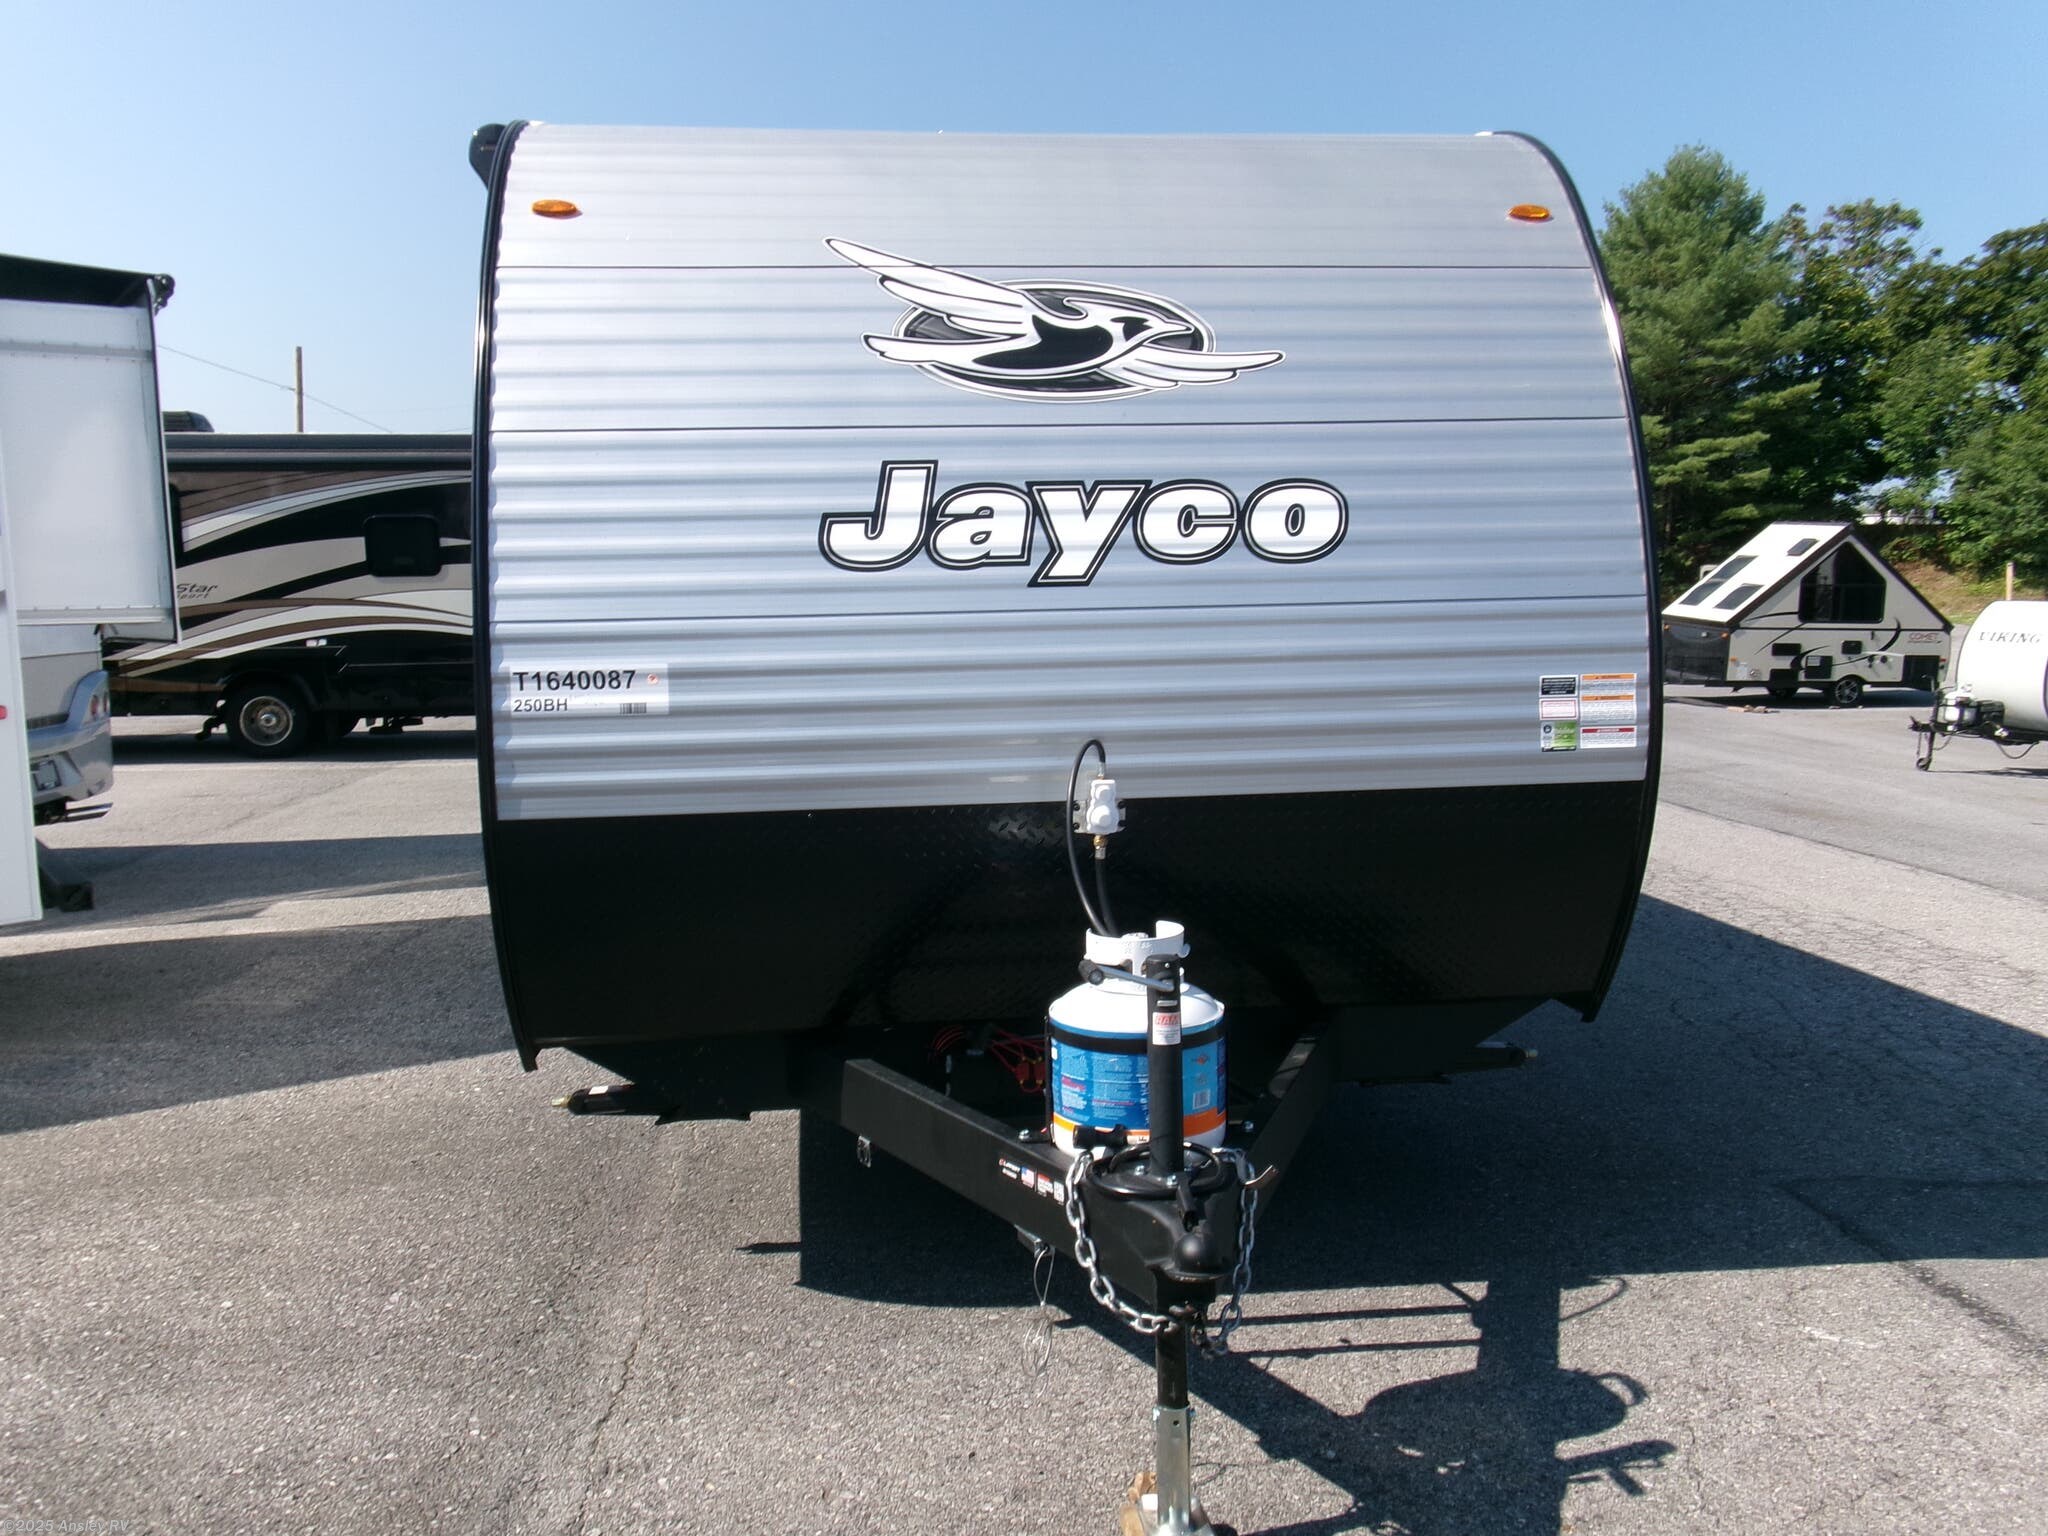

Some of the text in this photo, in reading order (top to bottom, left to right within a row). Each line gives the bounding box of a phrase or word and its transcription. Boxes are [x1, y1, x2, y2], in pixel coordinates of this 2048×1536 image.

[818, 460, 1349, 588] Jayco
[1979, 631, 2041, 643] VIKING
[512, 669, 637, 691] T1640087
[513, 698, 568, 713] 250BH
